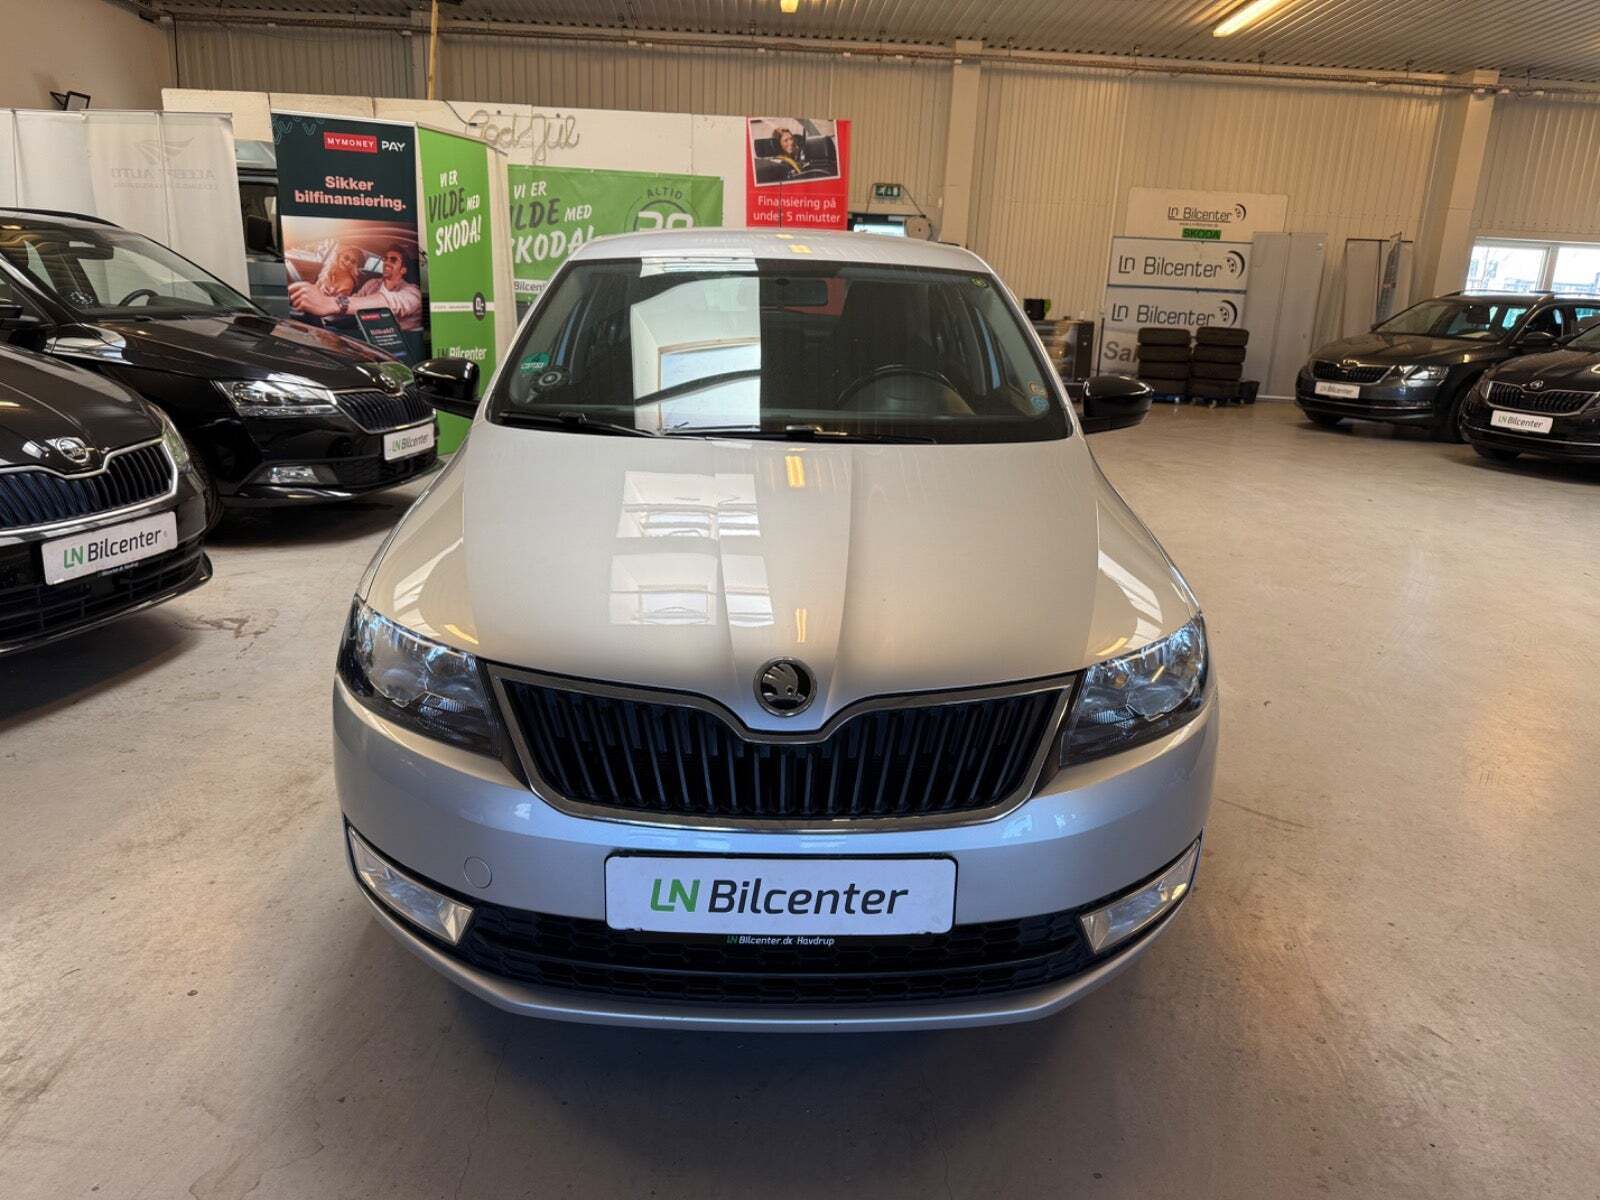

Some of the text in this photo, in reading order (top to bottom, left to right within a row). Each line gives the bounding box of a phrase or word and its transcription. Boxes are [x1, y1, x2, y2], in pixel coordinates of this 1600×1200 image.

[327, 137, 406, 152] MYMONEY PAY
[325, 176, 374, 191] Sikker
[439, 170, 458, 188] VI ER
[513, 180, 547, 200] VI ER
[646, 186, 683, 200] ALTID
[294, 190, 407, 212] bilfinansiering.
[428, 187, 480, 224] VILDE MED
[758, 195, 837, 210] Finansiering på
[564, 204, 593, 222] MED
[753, 211, 840, 223] under 5 minutter
[1183, 206, 1232, 221] Bilcenter
[435, 214, 482, 256] SKODA!
[1143, 256, 1222, 278] Bilcenter
[1136, 304, 1216, 329] Bilcenter
[449, 346, 487, 360] Bilcenter
[1507, 416, 1544, 428] Bilcenter
[401, 433, 429, 450] Bilcenter
[63, 545, 83, 569] LN
[87, 529, 162, 562] Bilcenter
[650, 877, 909, 915] LN Bilcenter
[738, 935, 793, 945] Bilcenter.dk
[797, 936, 835, 947] Havdrup
